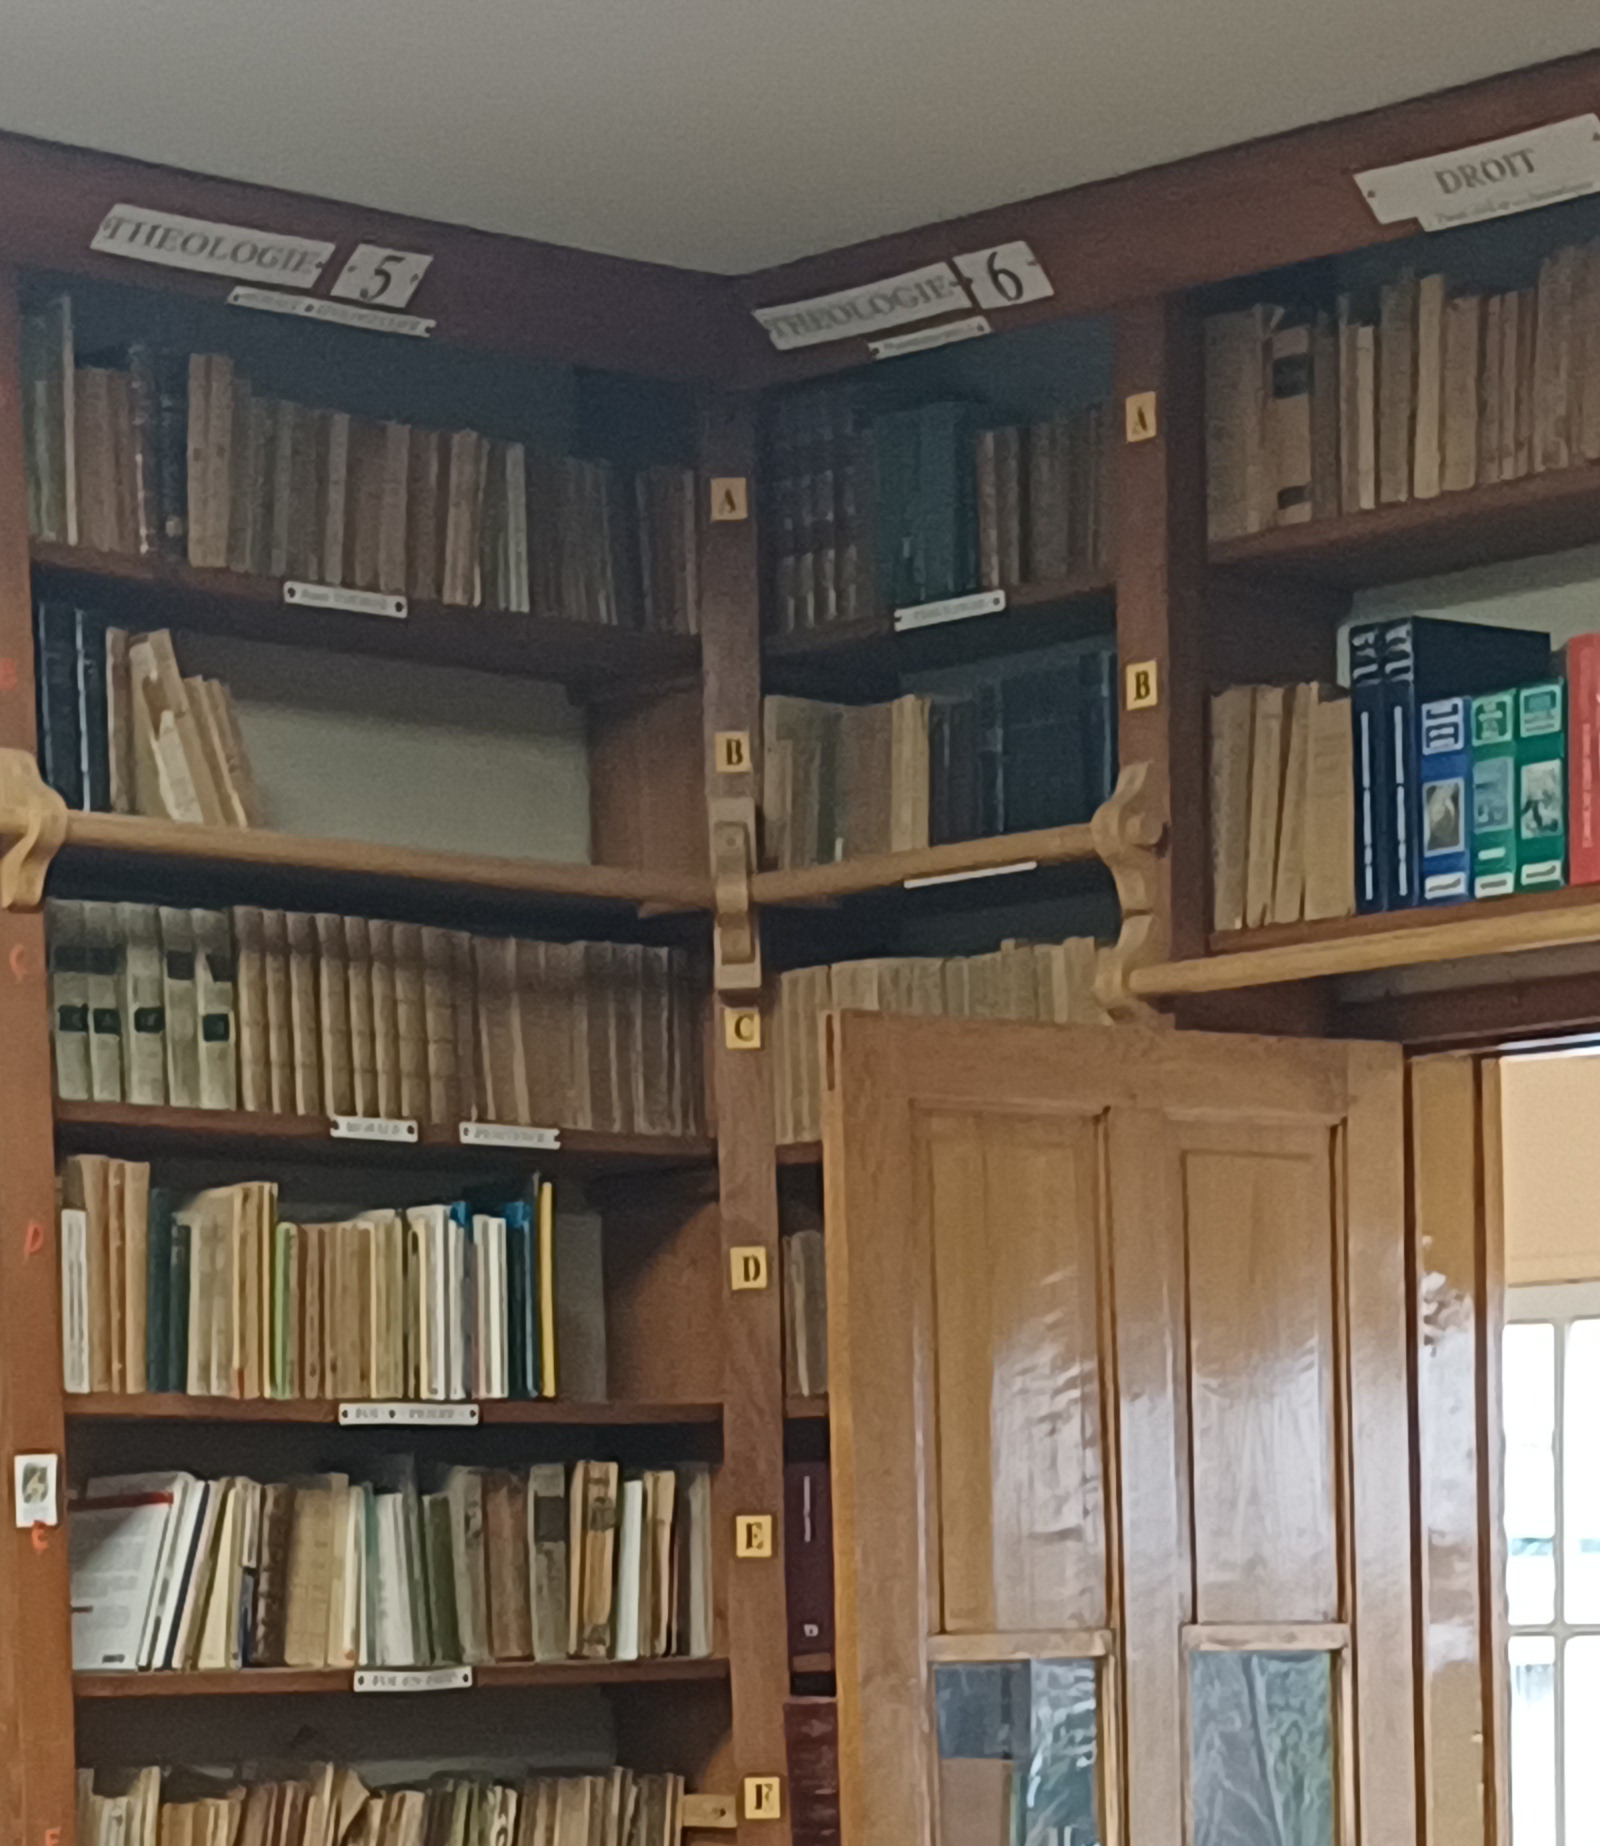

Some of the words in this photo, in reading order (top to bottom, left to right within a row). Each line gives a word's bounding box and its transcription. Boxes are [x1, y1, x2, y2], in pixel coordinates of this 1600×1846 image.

[1435, 148, 1536, 196] DROIT
[104, 216, 322, 276] THEOLOGIE
[358, 254, 407, 303] 5
[985, 250, 1025, 302] 6
[765, 275, 956, 339] THEOLOGIE
[1130, 405, 1150, 435] A
[717, 487, 738, 516] A
[1133, 670, 1152, 702] B
[725, 735, 744, 767] B
[732, 1012, 756, 1043] C
[742, 1255, 762, 1284] D
[744, 1521, 765, 1551] E
[754, 1781, 775, 1811] F
